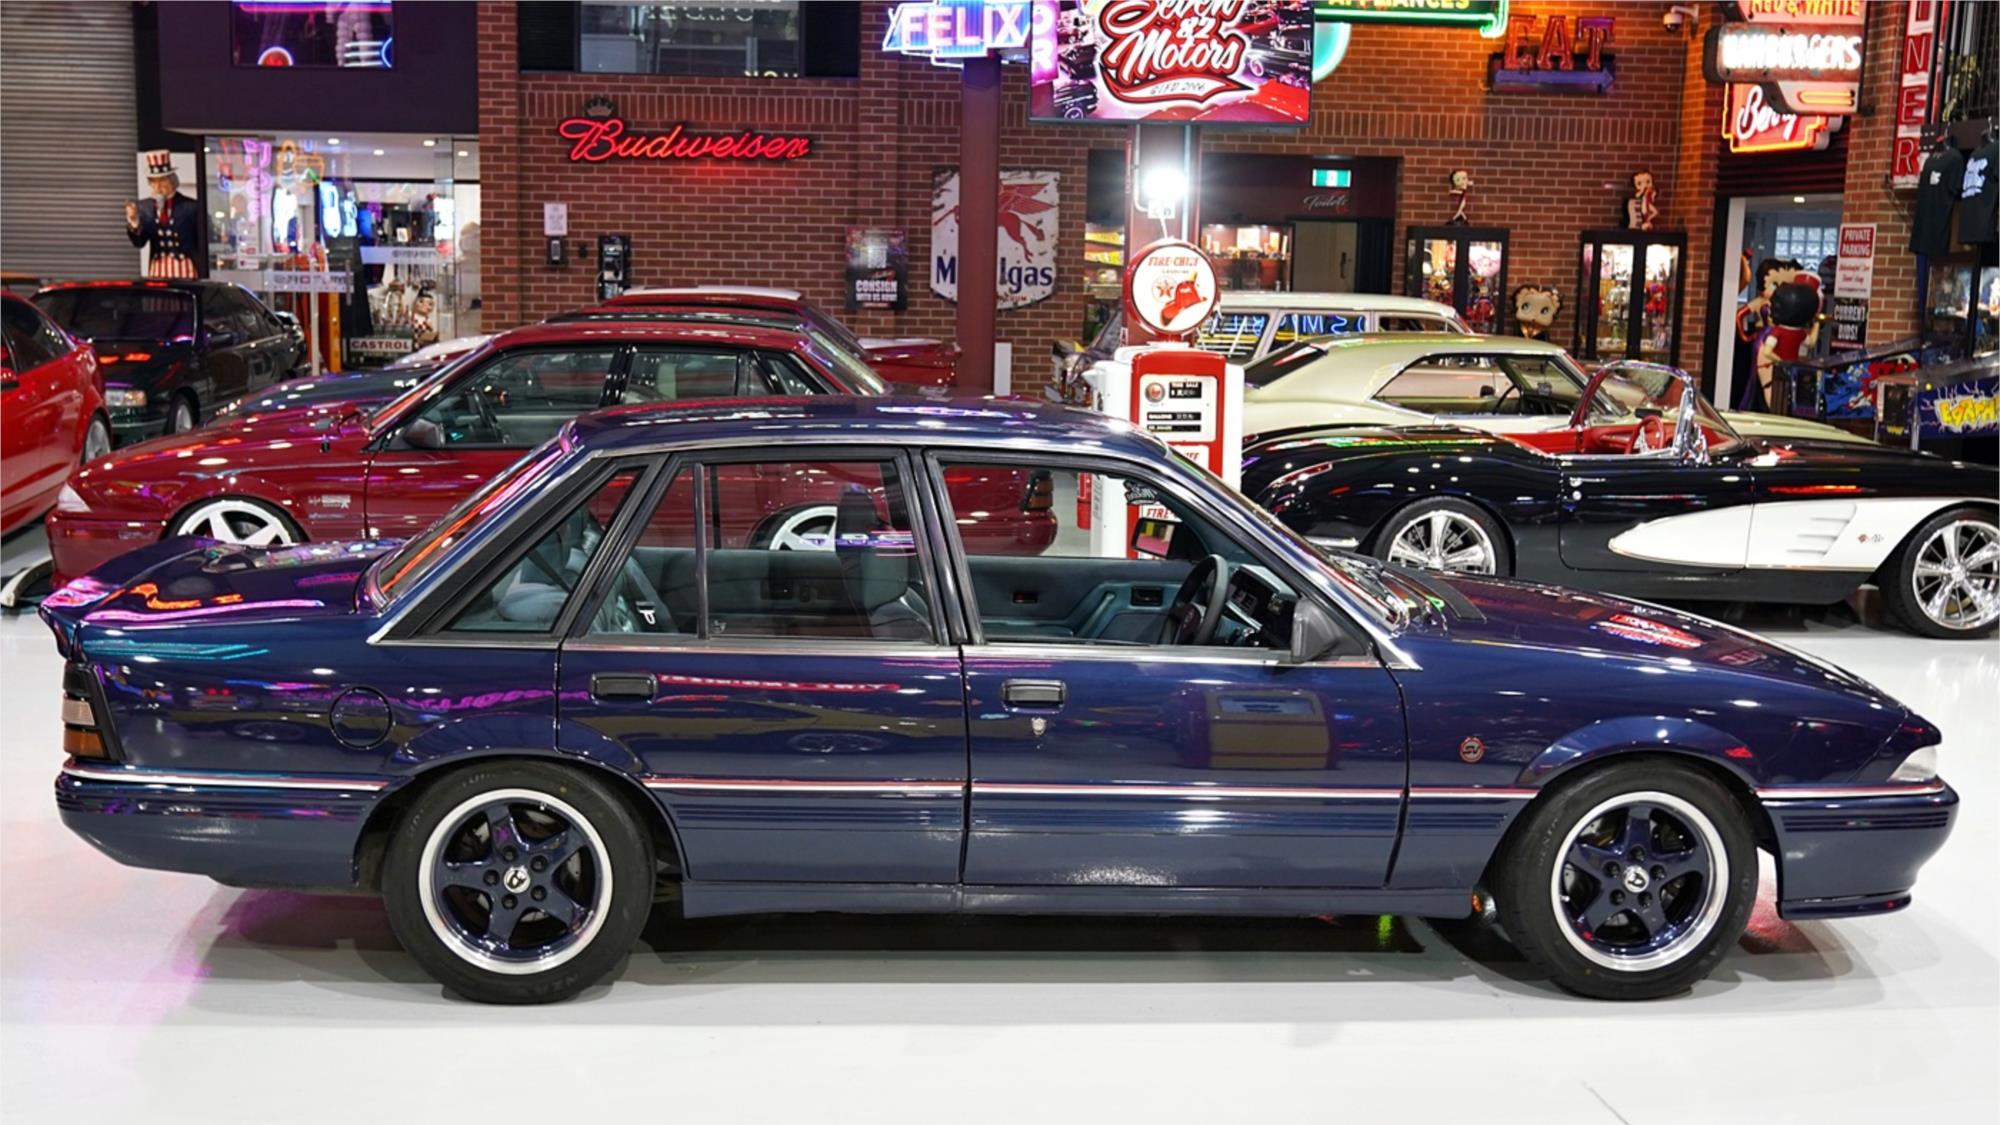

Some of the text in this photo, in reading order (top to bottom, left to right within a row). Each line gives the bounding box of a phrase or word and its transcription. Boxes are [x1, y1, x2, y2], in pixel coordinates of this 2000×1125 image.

[901, 6, 1024, 48] FELIX
[1503, 15, 1616, 70] EAT
[1107, 28, 1240, 82] Motors
[559, 118, 809, 161] Budweiser
[1841, 243, 1871, 257] PARKING
[1844, 228, 1872, 242] PRIVATE
[856, 279, 898, 292] CONSIGN
[936, 255, 1053, 294] Mlgas
[351, 340, 411, 350] CASTROL
